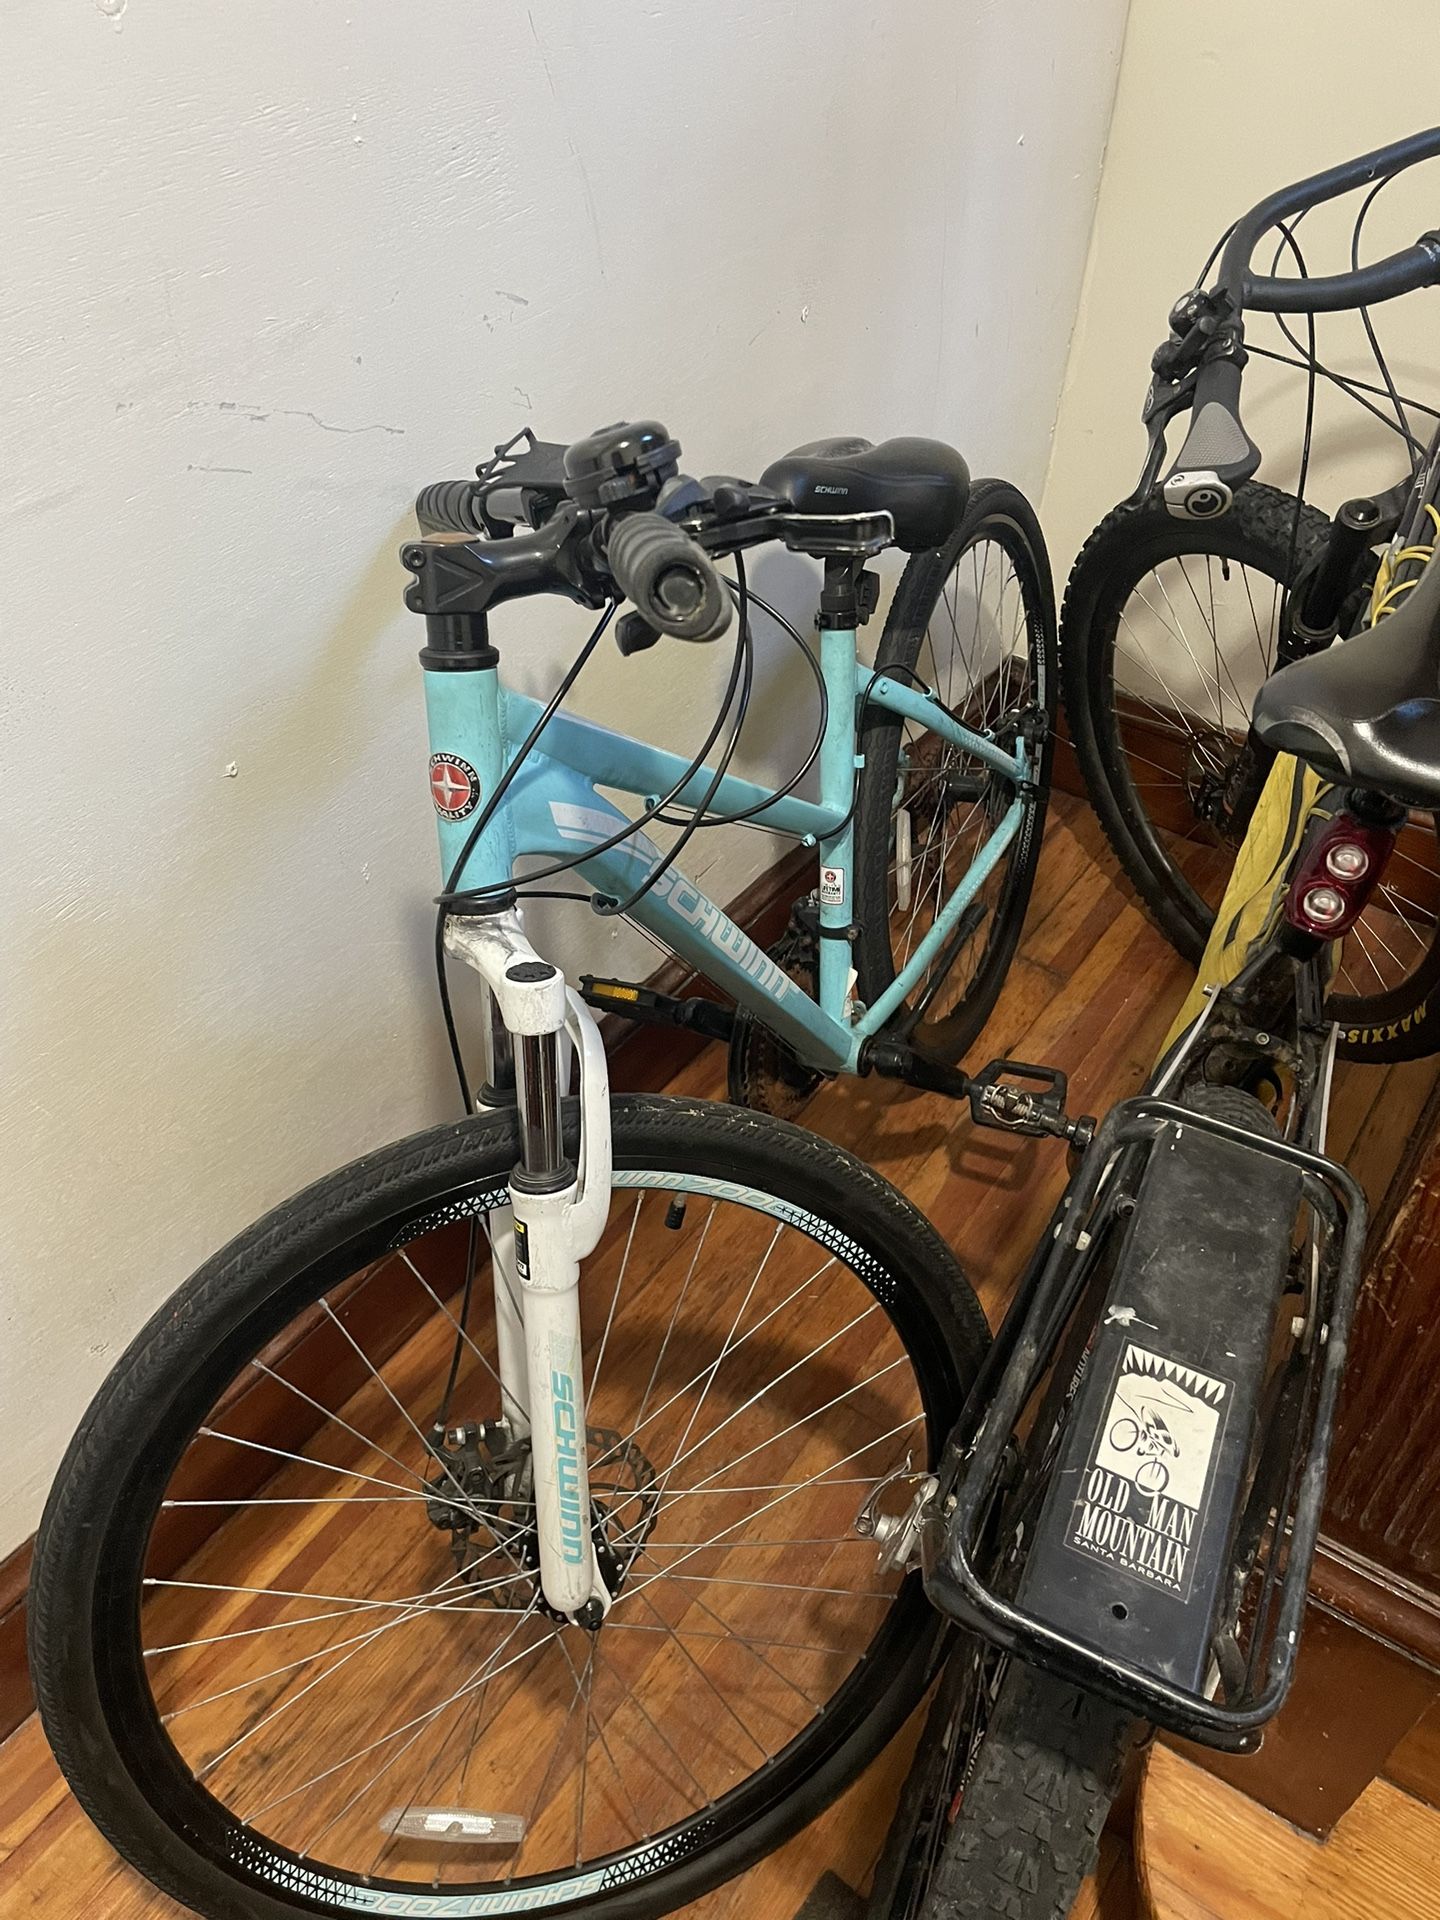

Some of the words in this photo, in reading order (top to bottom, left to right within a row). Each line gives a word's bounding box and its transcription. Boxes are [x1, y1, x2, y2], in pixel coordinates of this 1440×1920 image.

[814, 485, 849, 495] SCHWINN
[642, 857, 788, 1000] SCHWINN
[1347, 1000, 1427, 1044] MAXXIS
[612, 1171, 684, 1187] WINN
[551, 1369, 584, 1565] SCHWINN
[1087, 1468, 1130, 1514] OLD
[1144, 1495, 1198, 1545] MAN
[1073, 1536, 1115, 1561] SANTA
[1119, 1558, 1181, 1592] BARBARA
[1075, 1501, 1190, 1582] MOUNTAIN
[467, 1876, 603, 1916] SCHWINN
